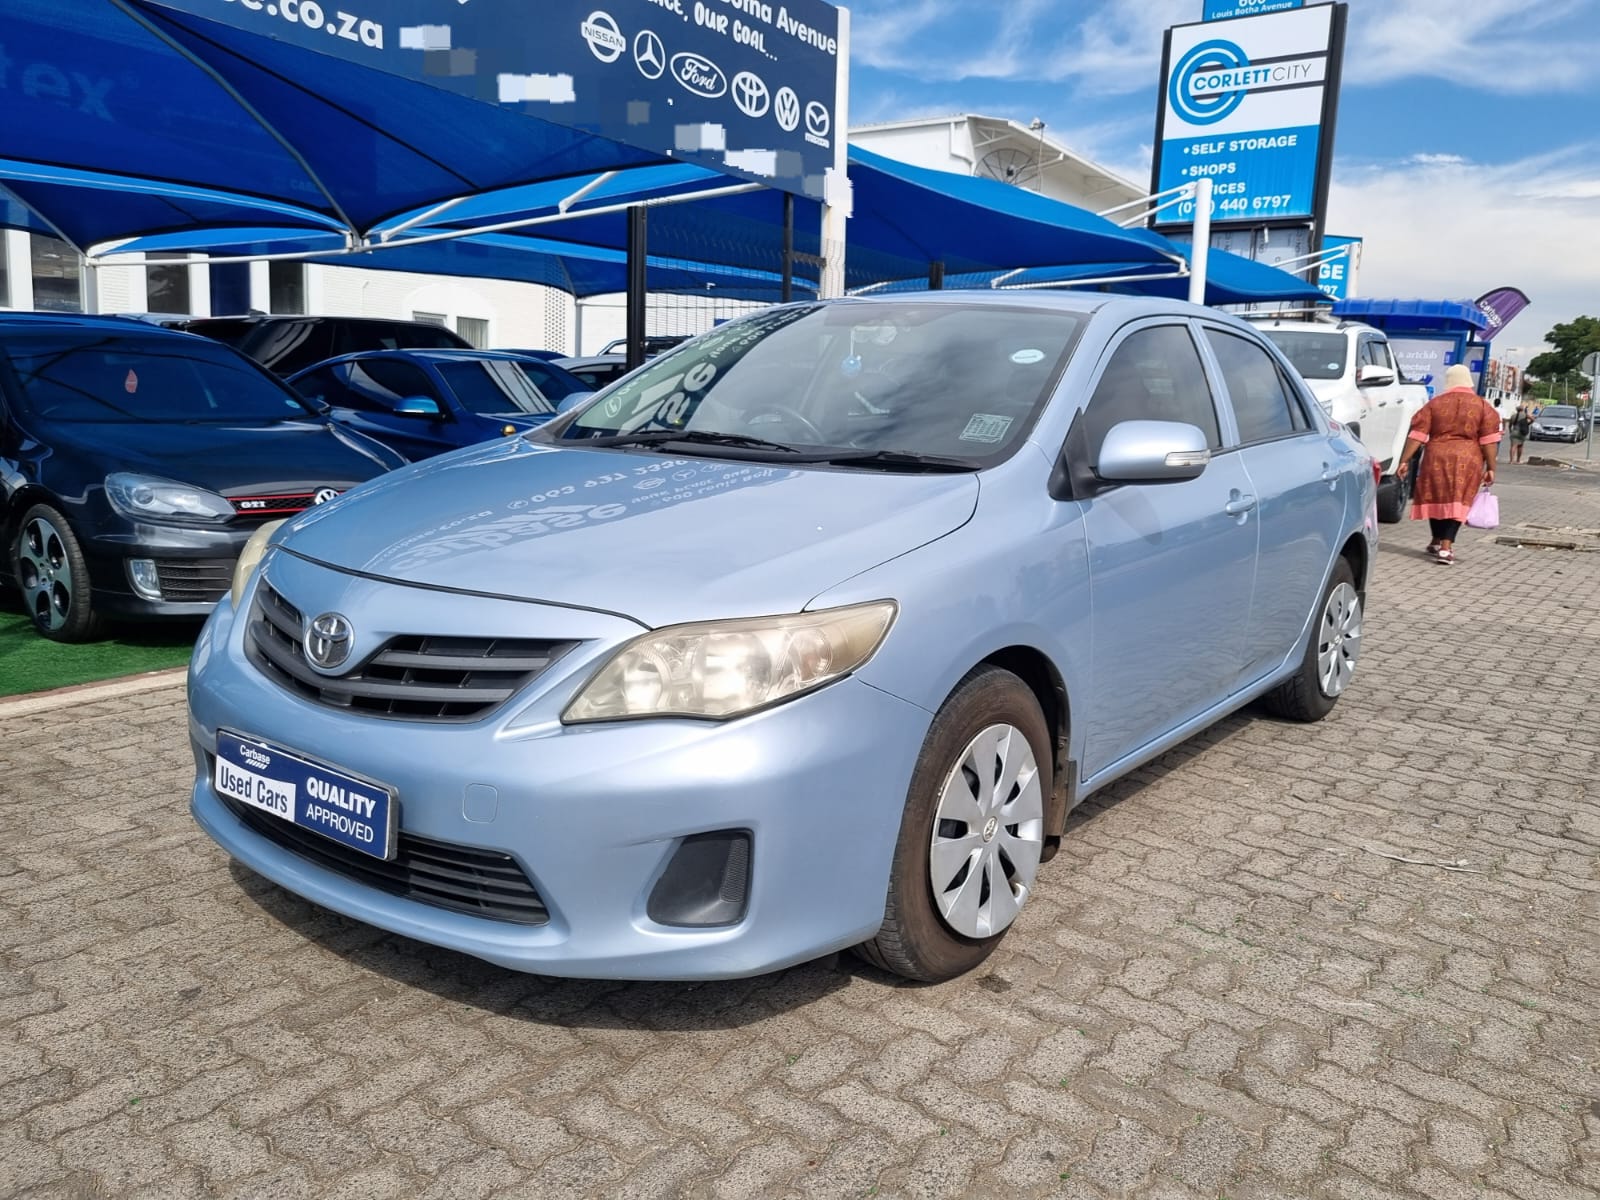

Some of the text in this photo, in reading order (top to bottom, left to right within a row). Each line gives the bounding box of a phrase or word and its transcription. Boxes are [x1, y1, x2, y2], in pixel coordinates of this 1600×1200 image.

[1211, 9, 1233, 19] Louis
[1235, 7, 1259, 16] Botha
[1260, 2, 1292, 12] Avenue
[584, 25, 624, 48] NISSAN
[776, 6, 837, 56] Avenue
[681, 58, 718, 91] Ford
[1191, 135, 1298, 155] SELF STORAGE
[1189, 162, 1237, 177] SHOPS
[1219, 198, 1248, 211] 440
[1252, 195, 1291, 209] 6797
[240, 500, 267, 509] GTI
[239, 744, 271, 765] Carbase
[220, 765, 289, 814] Used Cars
[306, 776, 377, 819] QUALITY
[305, 803, 374, 844] APPROVED
